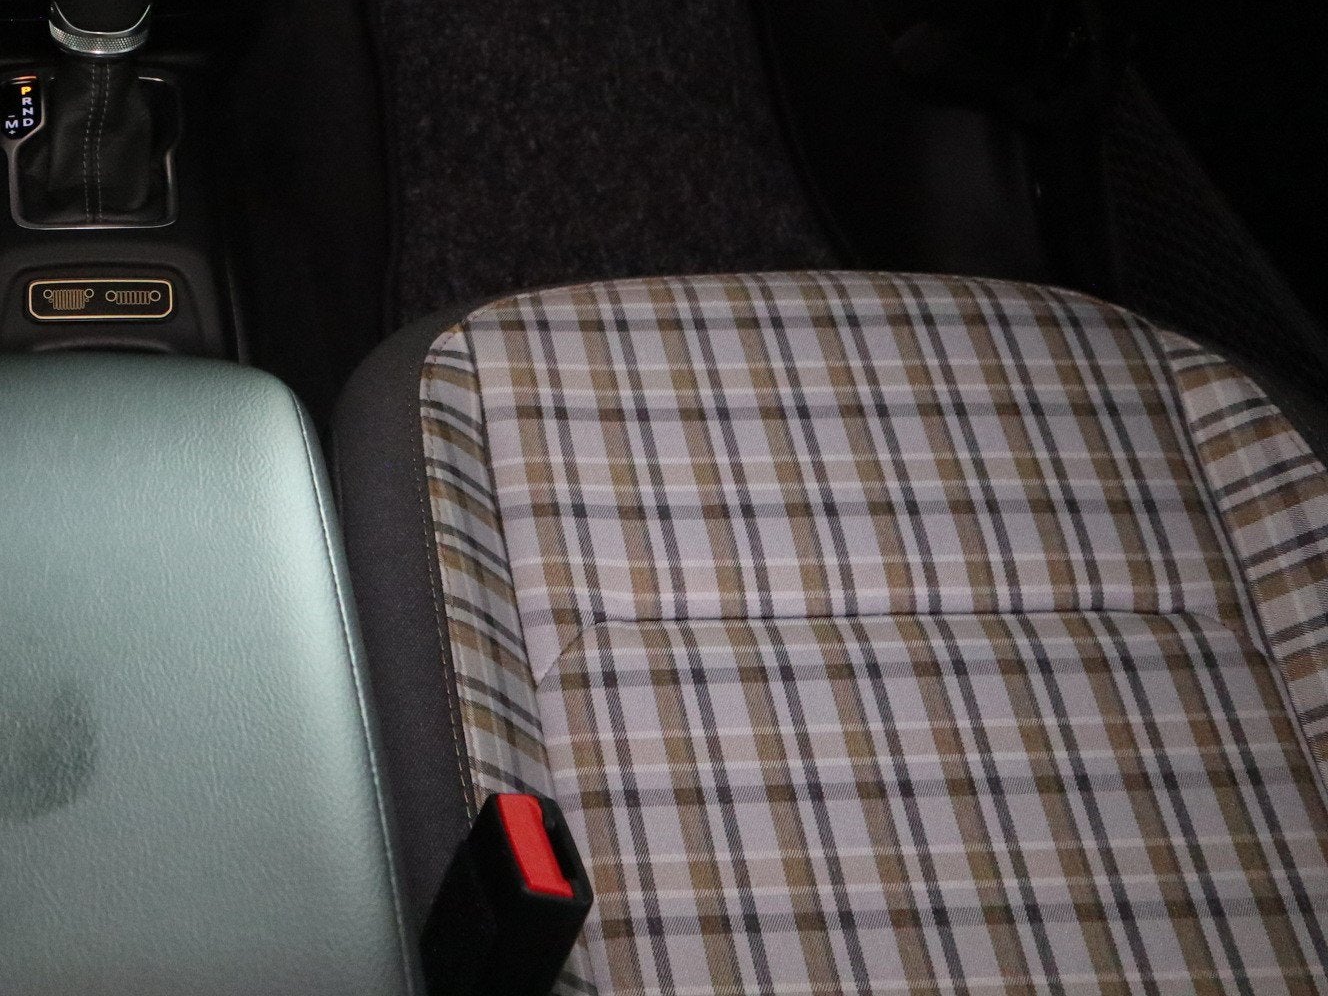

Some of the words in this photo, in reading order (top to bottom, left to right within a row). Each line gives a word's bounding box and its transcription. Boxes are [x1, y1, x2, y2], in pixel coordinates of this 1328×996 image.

[21, 86, 31, 95] P
[22, 97, 33, 106] R
[22, 107, 34, 117] N
[5, 120, 19, 129] M
[23, 118, 34, 127] D
